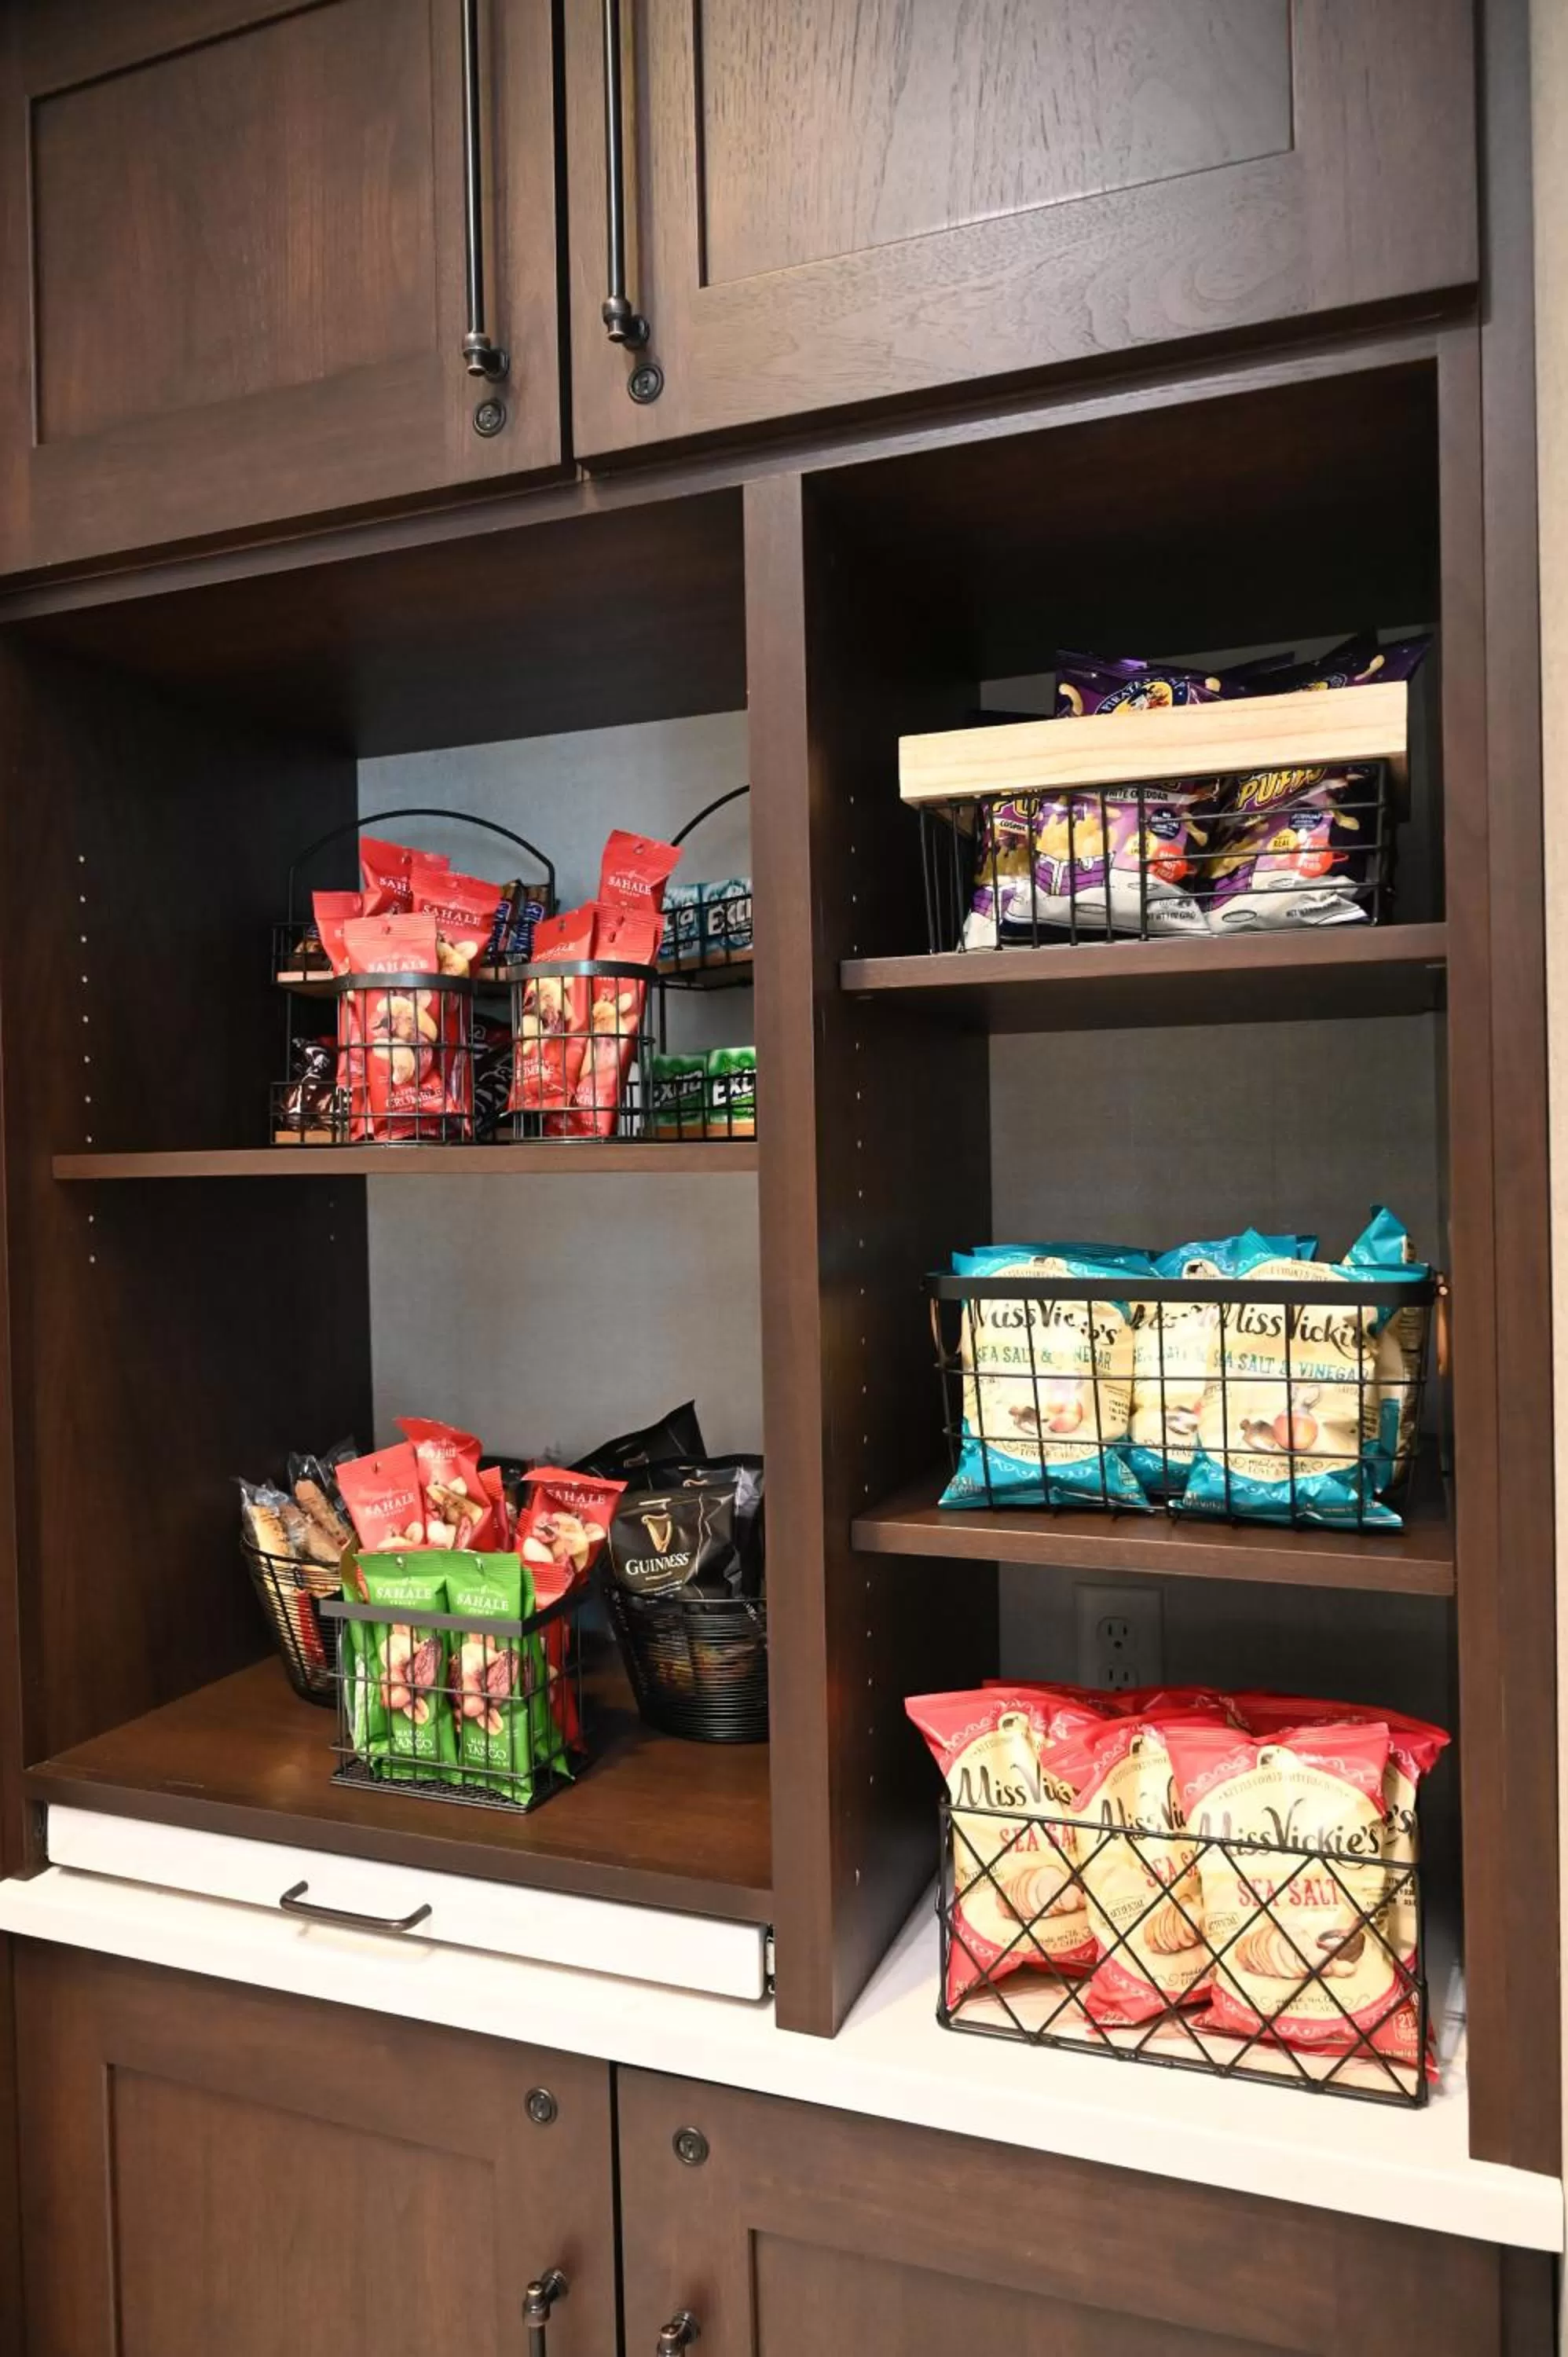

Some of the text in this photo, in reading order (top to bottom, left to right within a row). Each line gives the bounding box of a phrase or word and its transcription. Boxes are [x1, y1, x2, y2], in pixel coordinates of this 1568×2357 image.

[1130, 789, 1168, 801] CEDDAR
[379, 876, 412, 894] SAH
[608, 875, 652, 896] SAHALE
[423, 904, 482, 926] SAHALE
[1213, 1348, 1233, 1369] SA
[1237, 1352, 1276, 1374] SALT
[364, 1492, 416, 1516] SAHALE
[625, 1552, 690, 1576] GUINNESS
[376, 1586, 432, 1600] SAHALE
[457, 1593, 509, 1611] SAHALE
[467, 1743, 507, 1761] TANGO
[955, 1765, 1027, 1808] Miss
[998, 1822, 1078, 1853] SEA SA
[1237, 1875, 1340, 1908] SEA SALT
